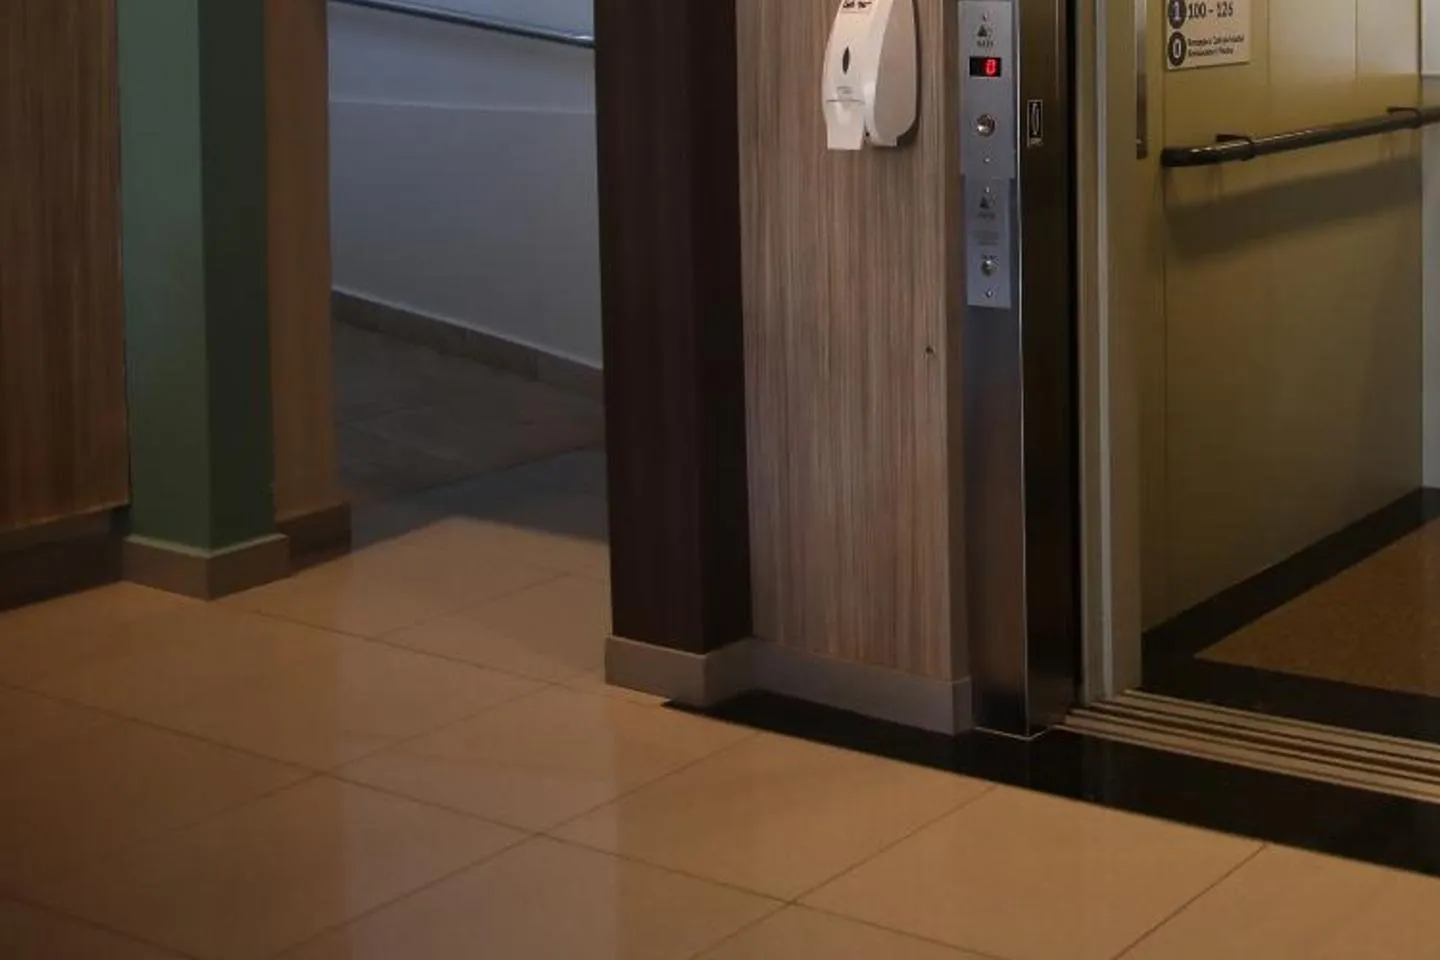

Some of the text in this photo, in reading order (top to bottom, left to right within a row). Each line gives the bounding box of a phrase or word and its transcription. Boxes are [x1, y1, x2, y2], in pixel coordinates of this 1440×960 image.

[1172, 1, 1182, 21] 1
[1172, 38, 1182, 58] 0
[985, 59, 996, 75] 0
